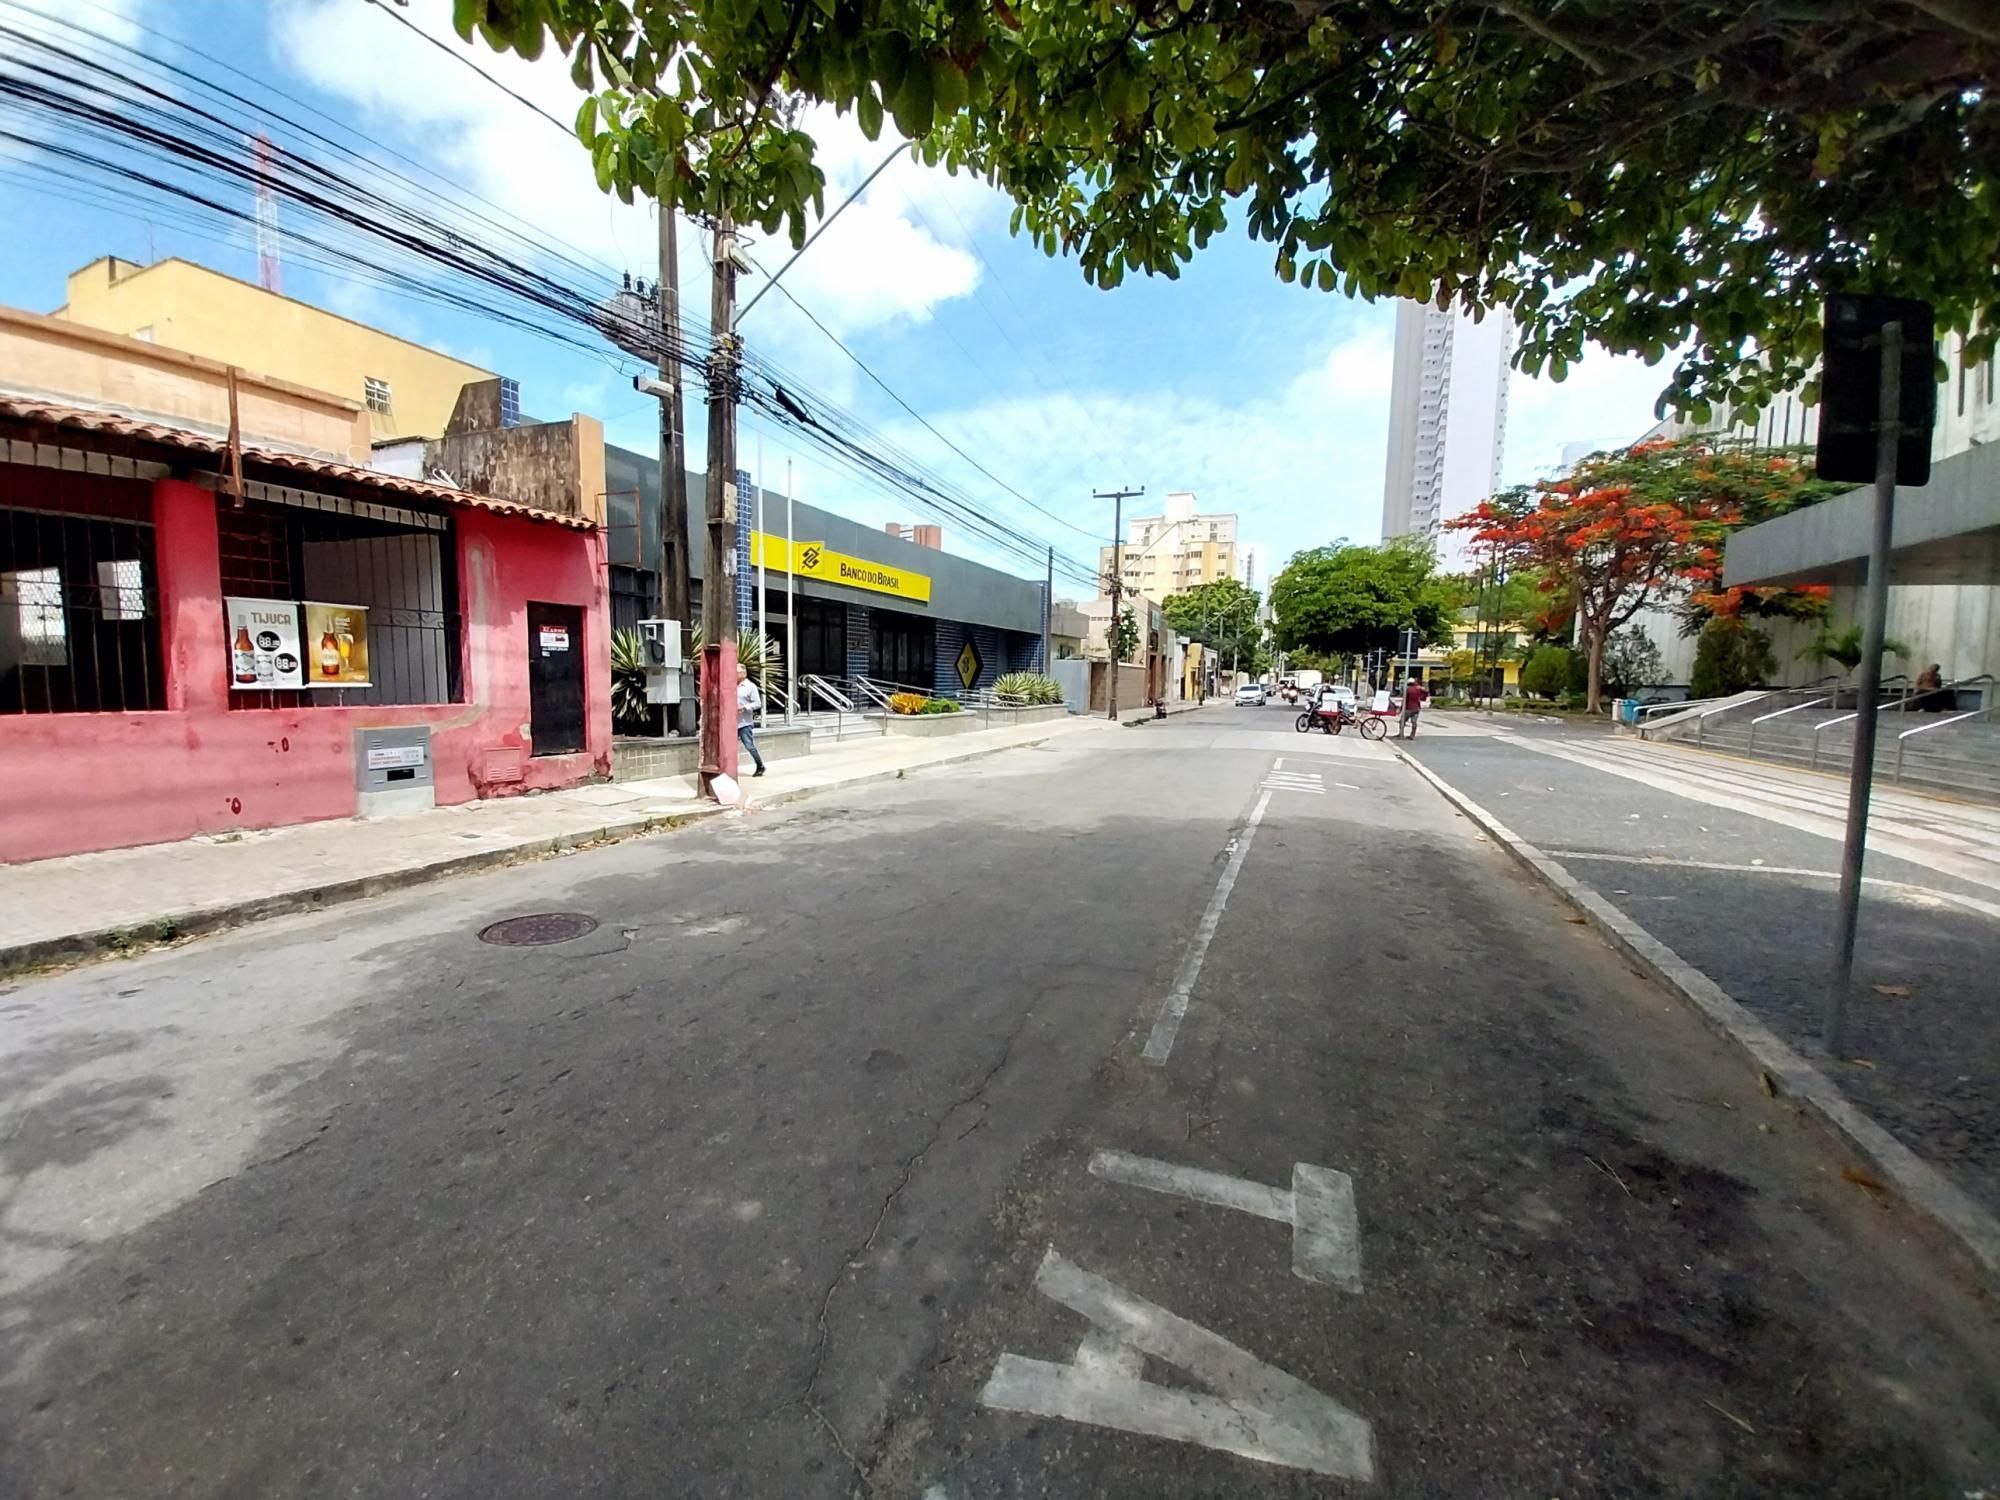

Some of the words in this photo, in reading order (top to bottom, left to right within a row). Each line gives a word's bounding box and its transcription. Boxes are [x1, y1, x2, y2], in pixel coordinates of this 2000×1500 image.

[840, 562, 866, 583] BANCO
[867, 572, 877, 585] DO
[878, 572, 900, 590] BRASIL
[251, 612, 292, 625] TIJUCA
[966, 1147, 1376, 1490] TA
